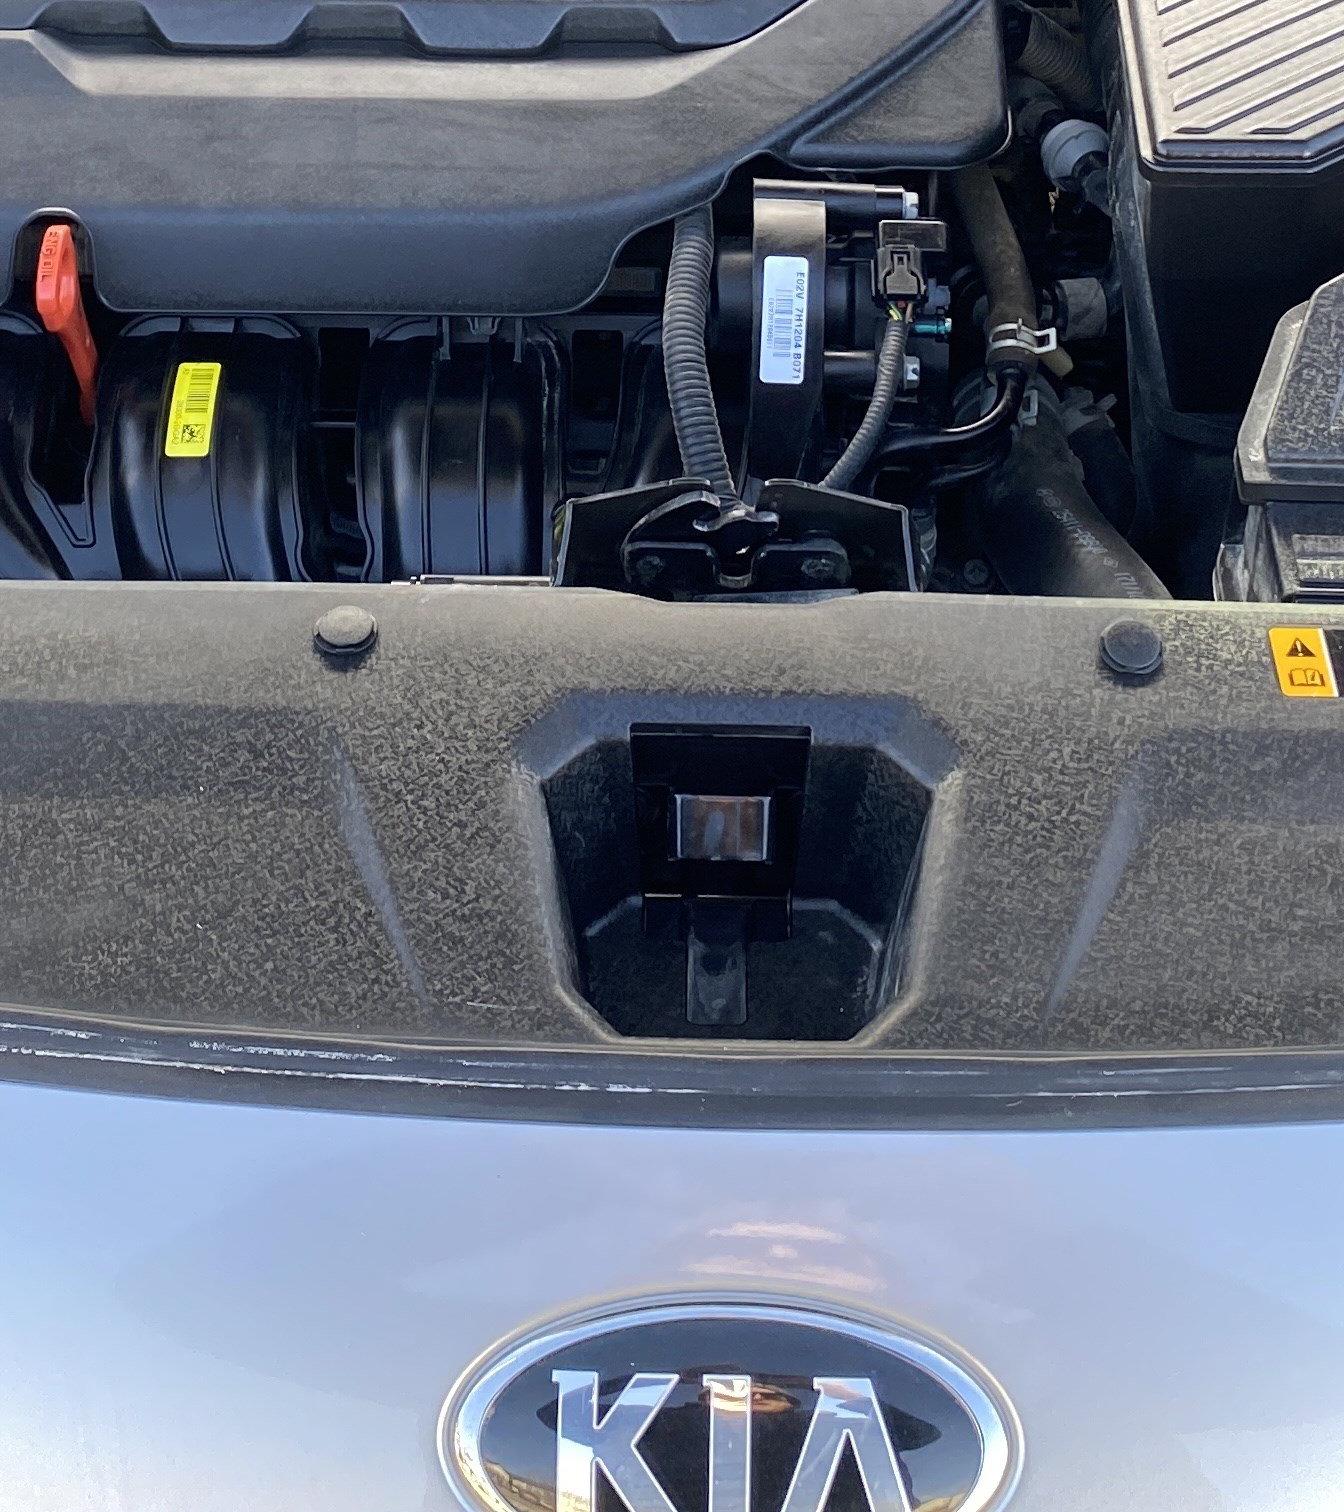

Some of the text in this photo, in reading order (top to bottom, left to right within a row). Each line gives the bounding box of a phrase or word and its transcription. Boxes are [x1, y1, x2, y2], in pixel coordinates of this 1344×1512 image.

[40, 231, 58, 283] ENG OIL
[792, 272, 806, 379] E02V 7H1204 B071
[552, 1370, 913, 1512] KIA
